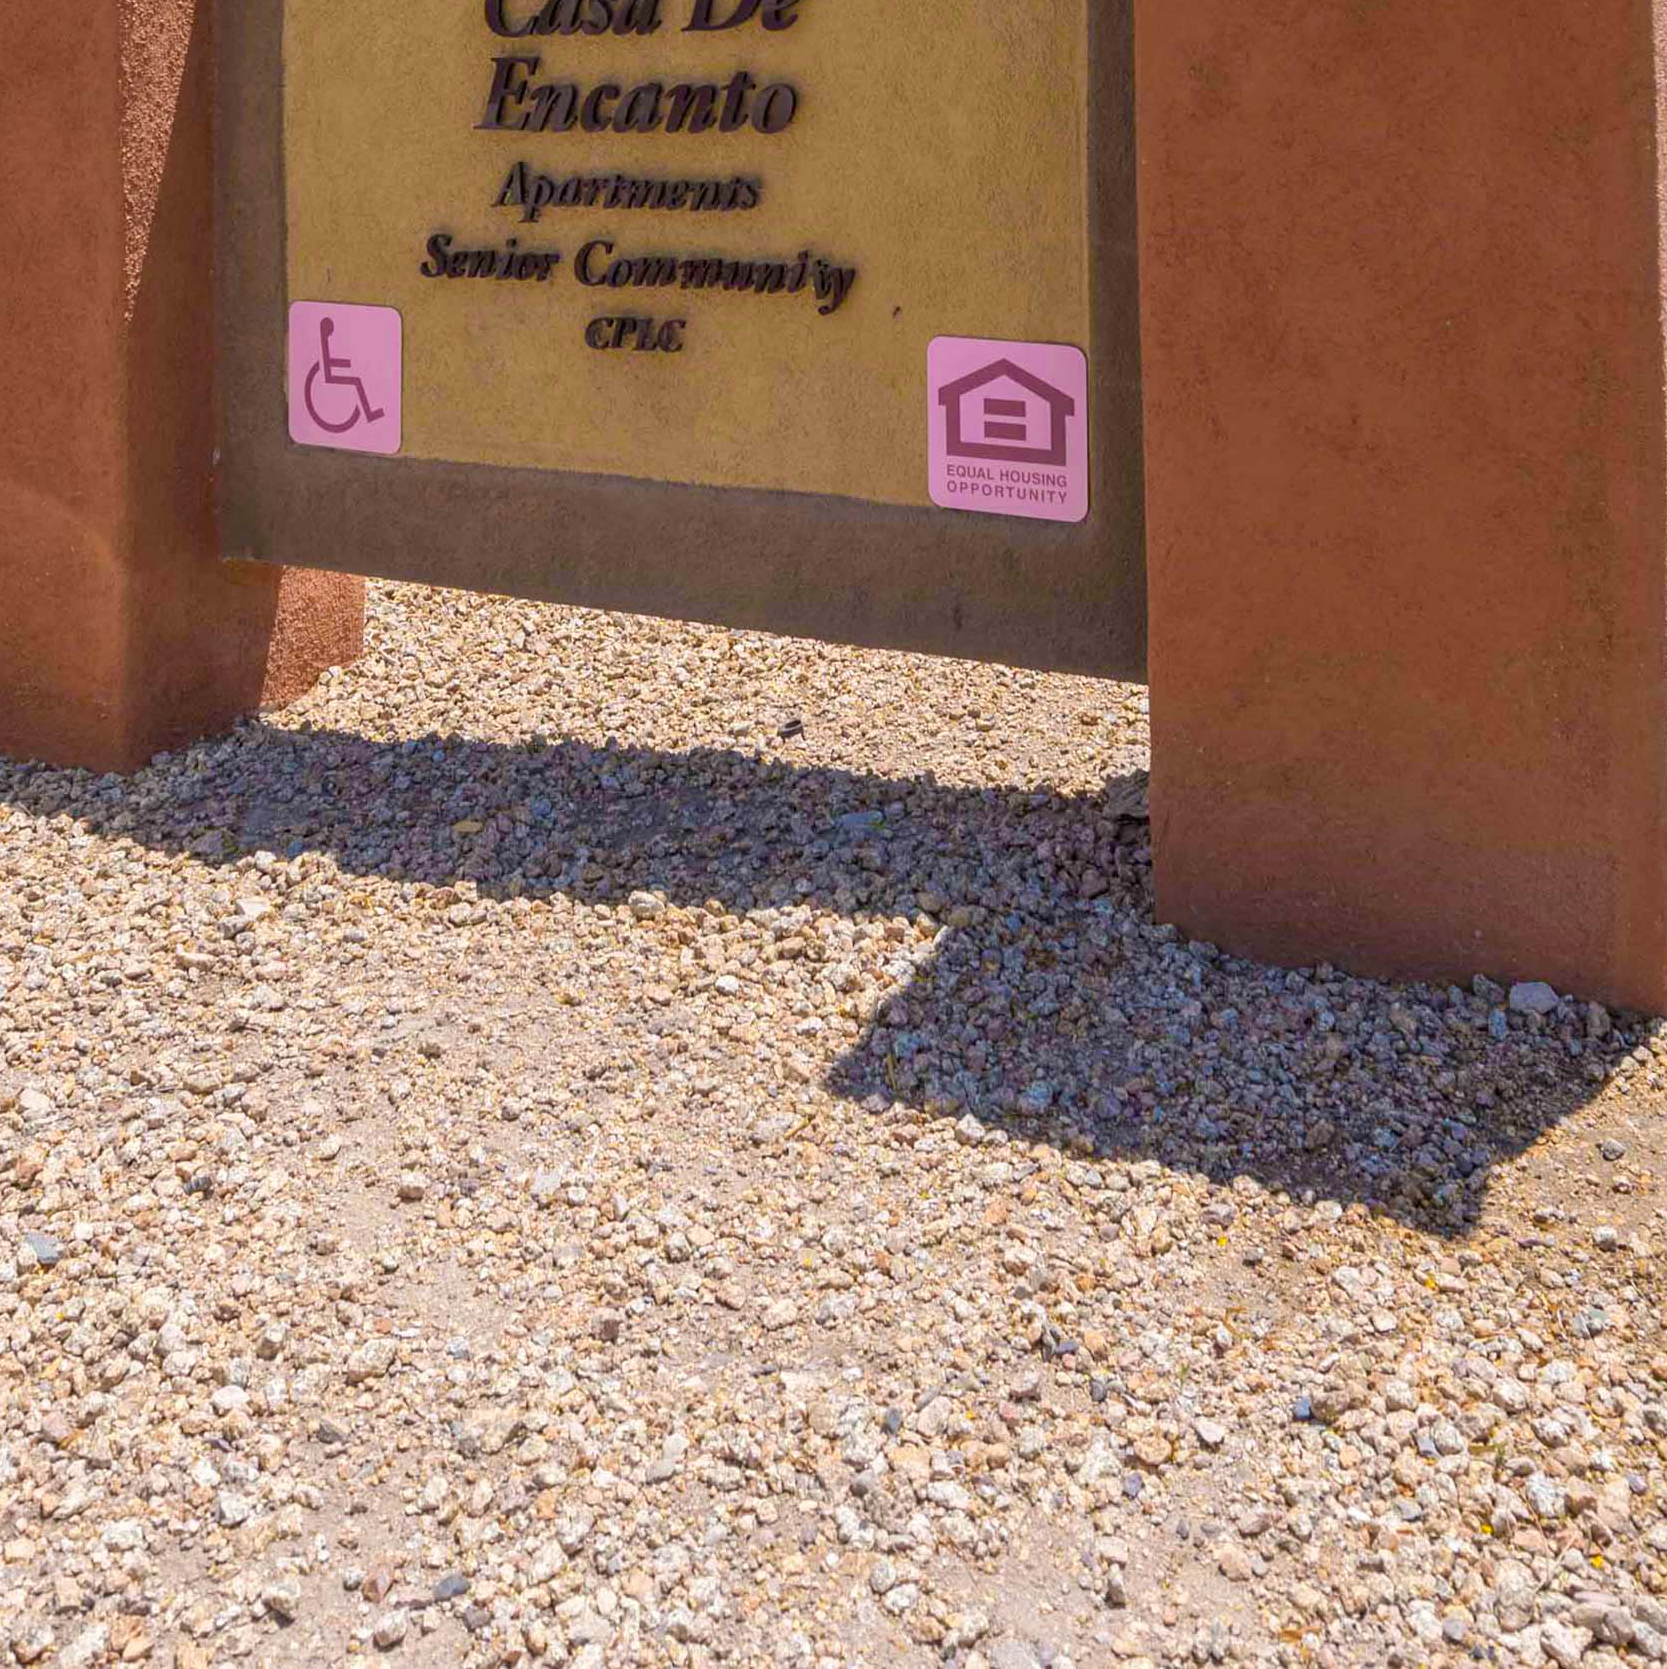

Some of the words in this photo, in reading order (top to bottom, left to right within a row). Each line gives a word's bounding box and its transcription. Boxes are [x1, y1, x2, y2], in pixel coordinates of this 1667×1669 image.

[474, 56, 799, 135] Encanto
[492, 160, 762, 223] Apartments
[420, 233, 560, 282] Senior
[573, 239, 856, 316] Community
[584, 316, 687, 354] CPLC
[946, 464, 995, 481] EQUAL
[999, 469, 1068, 488] HOUSING
[946, 480, 1068, 504] OPPORTUNITY
